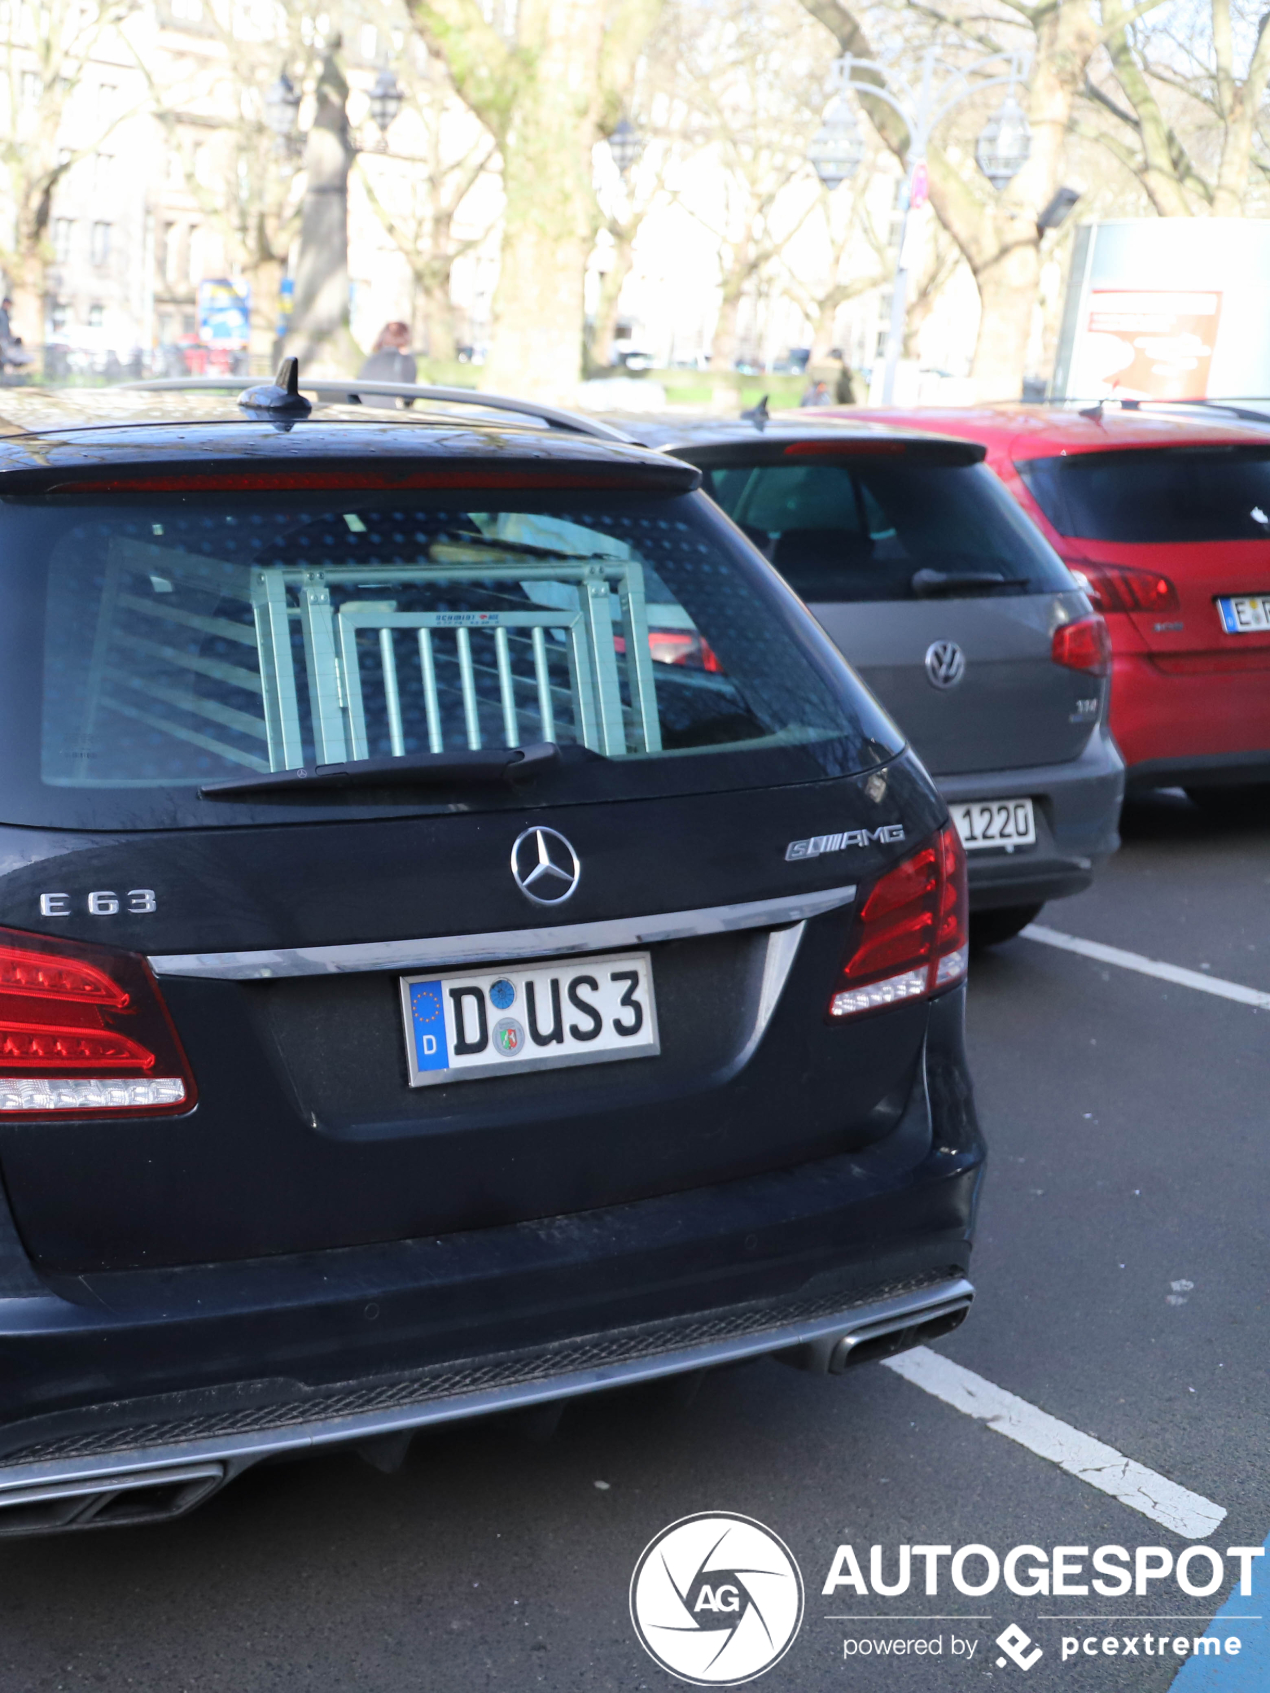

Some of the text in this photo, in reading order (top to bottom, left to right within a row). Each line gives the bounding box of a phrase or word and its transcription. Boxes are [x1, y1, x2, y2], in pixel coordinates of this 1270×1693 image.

[1234, 600, 1252, 625] E
[962, 802, 1030, 842] 1220
[40, 889, 158, 917] E 63
[448, 985, 489, 1056] D
[422, 1034, 438, 1056] D
